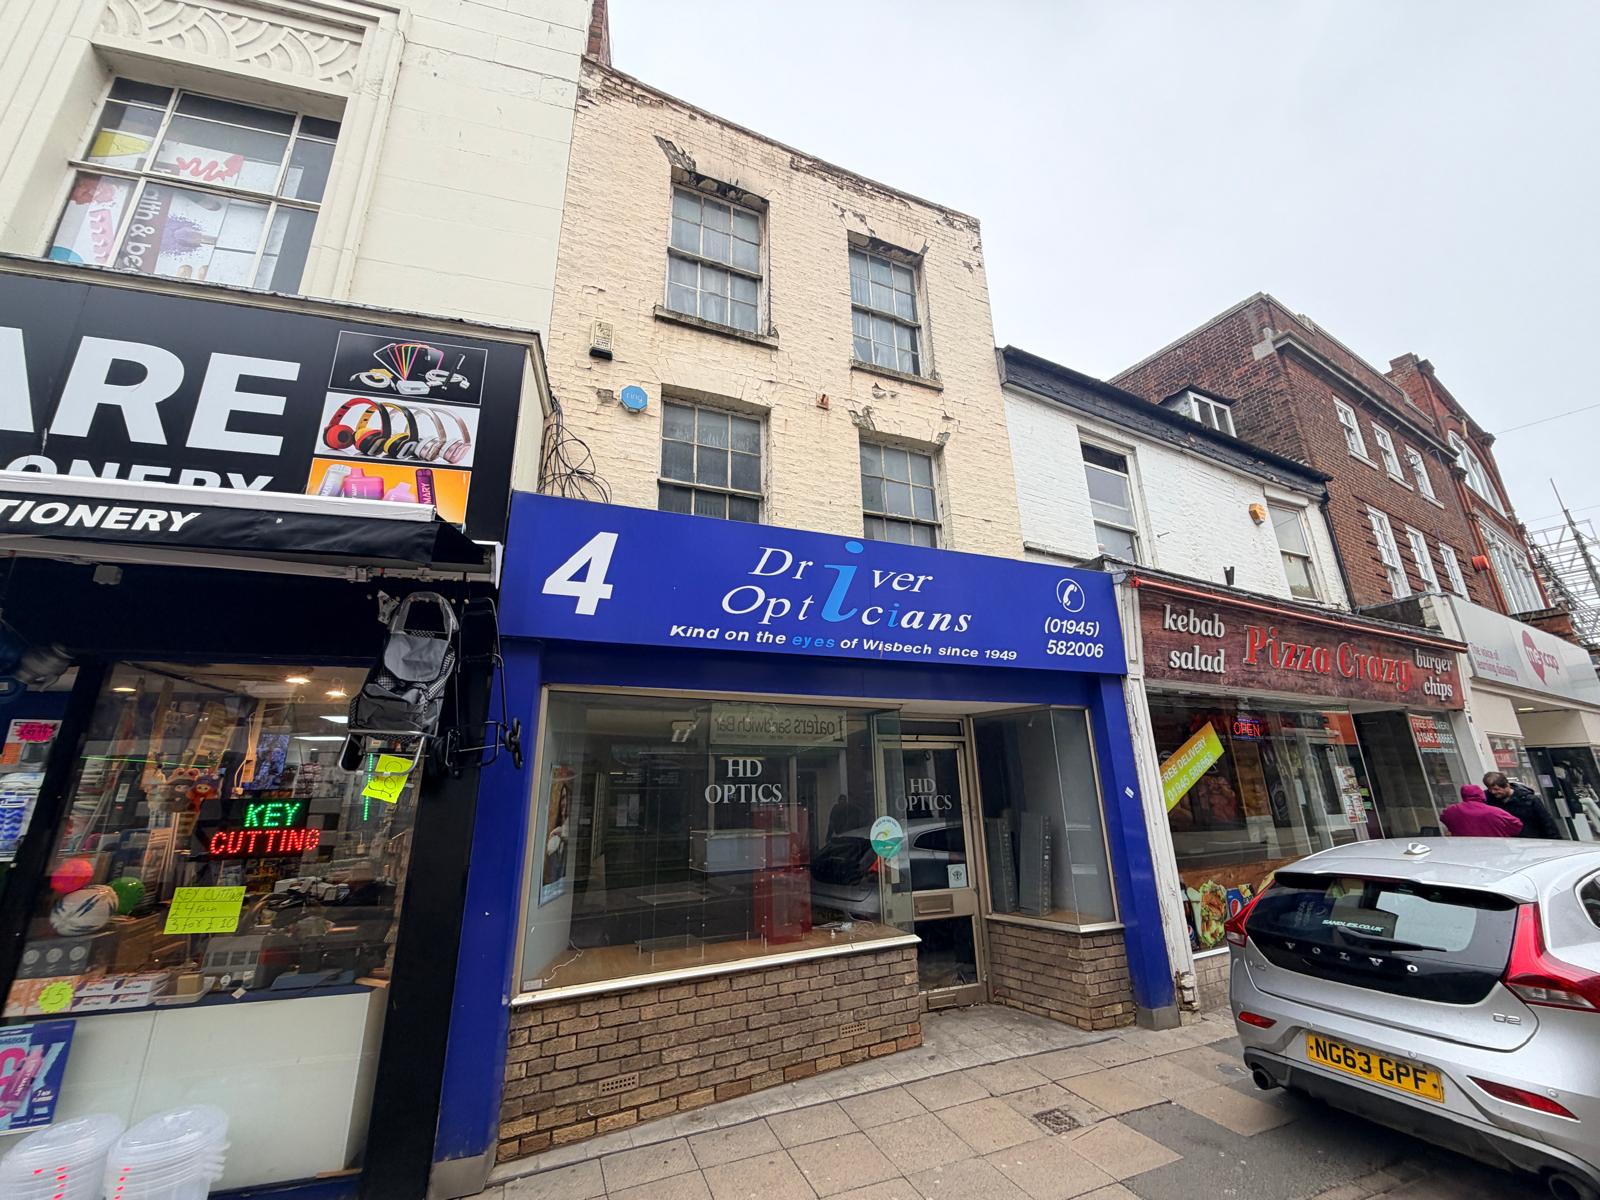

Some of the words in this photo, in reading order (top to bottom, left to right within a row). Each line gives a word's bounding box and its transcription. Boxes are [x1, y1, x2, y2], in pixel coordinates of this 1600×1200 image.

[122, 241, 151, 274] be
[0, 326, 300, 456] RE
[423, 483, 433, 504] MARY
[541, 531, 619, 616] 4
[1044, 617, 1100, 638] (01945)
[1163, 604, 1226, 639] kebab
[670, 624, 720, 640] Kind
[729, 629, 749, 642] on
[756, 630, 786, 645] the
[792, 634, 835, 649] eyes
[840, 638, 858, 650] of
[863, 639, 932, 655] Wisbech
[938, 645, 979, 658] since
[984, 649, 1017, 661] 1949
[1046, 639, 1104, 659] 582006
[1168, 644, 1226, 674] salad
[1243, 624, 1331, 674] Pizza
[1335, 641, 1410, 693] Crazy
[1415, 648, 1453, 675] burger
[1424, 676, 1453, 701] chips
[1233, 721, 1261, 737] OPEN
[1177, 735, 1207, 768] DELIVERY
[726, 758, 762, 778] HD
[704, 782, 783, 806] OPTICS
[909, 777, 936, 793] HD
[244, 803, 301, 828] KEY
[895, 793, 953, 812] OPTICS
[210, 828, 321, 855] CUTTING
[1493, 1012, 1521, 1025] D2
[1314, 1036, 1373, 1075] NG63
[1379, 1058, 1428, 1091] GPF
